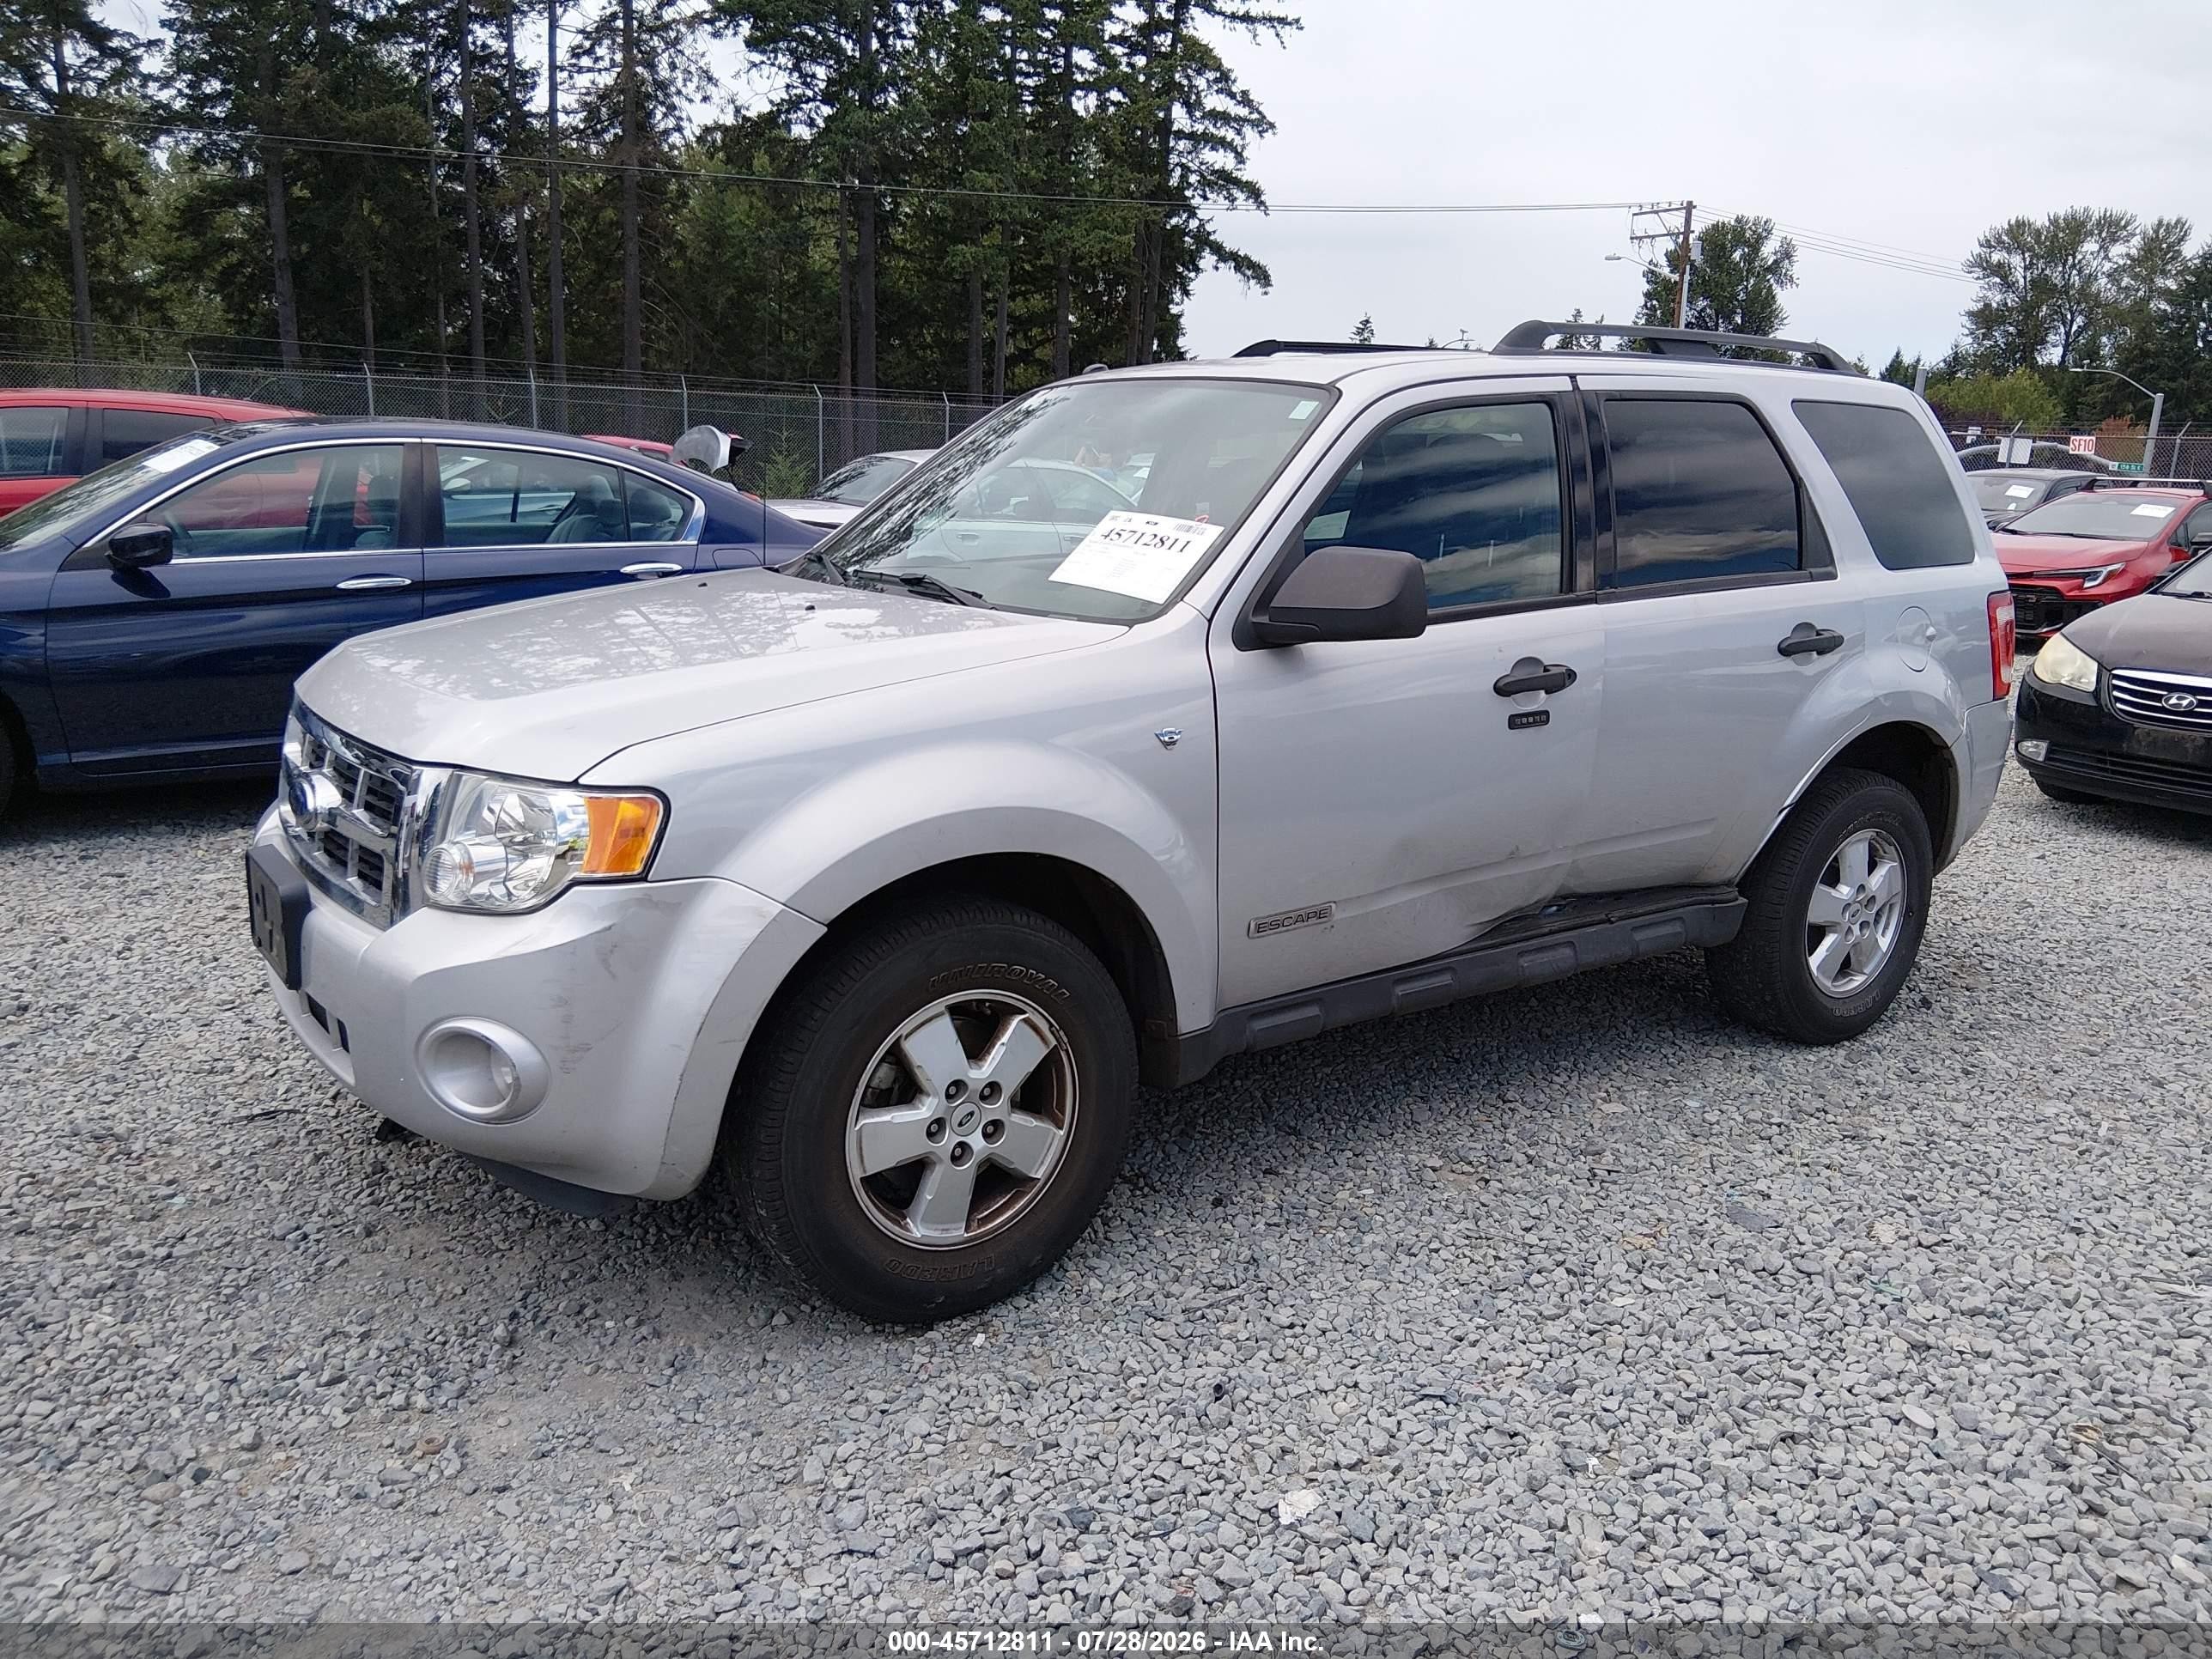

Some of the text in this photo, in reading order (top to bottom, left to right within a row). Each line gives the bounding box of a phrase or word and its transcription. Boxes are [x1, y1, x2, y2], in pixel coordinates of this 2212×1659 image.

[2070, 438, 2094, 453] SF10
[1100, 526, 1192, 554] 45712811
[1256, 908, 1329, 934] ESCAPE
[928, 963, 1072, 1006] UNIROYAL
